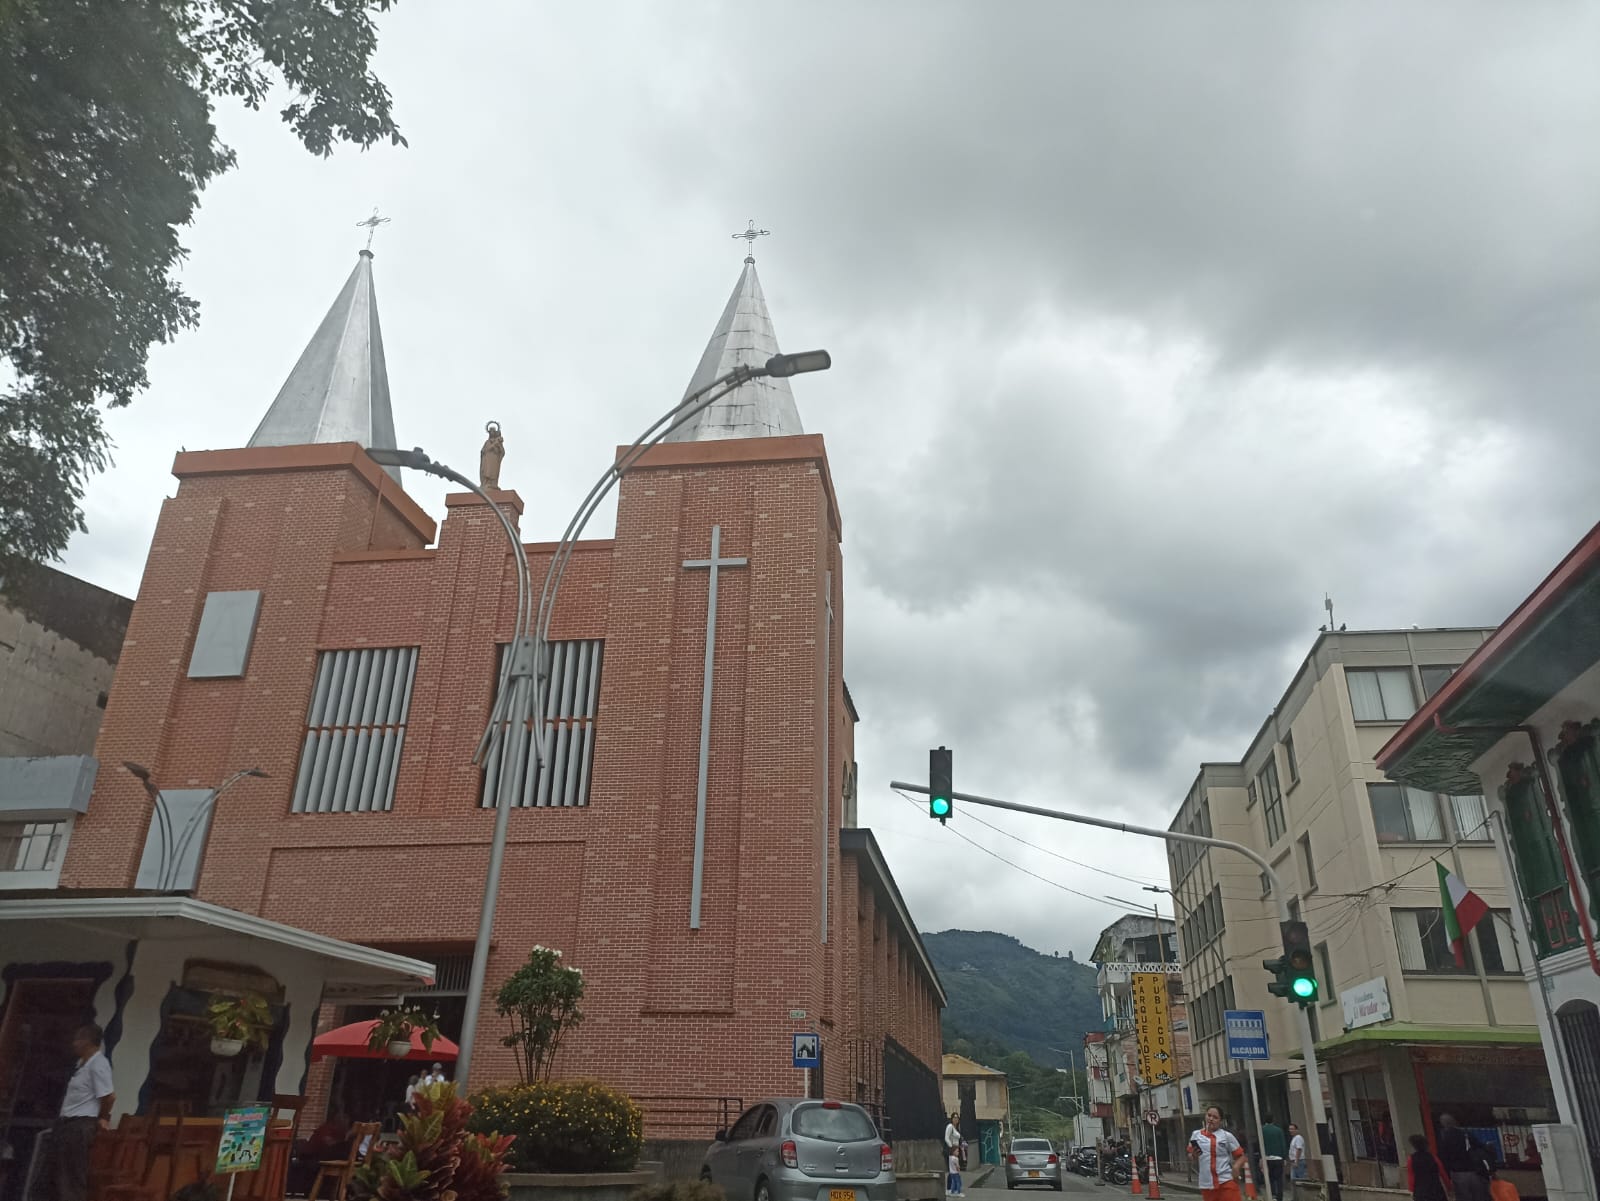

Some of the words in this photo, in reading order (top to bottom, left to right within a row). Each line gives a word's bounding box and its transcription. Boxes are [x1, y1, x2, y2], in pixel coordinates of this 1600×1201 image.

[1138, 976, 1152, 1084] PARQUEADERO
[1152, 976, 1165, 1046] PUBLICO
[1231, 1046, 1265, 1055] ALCALDIA
